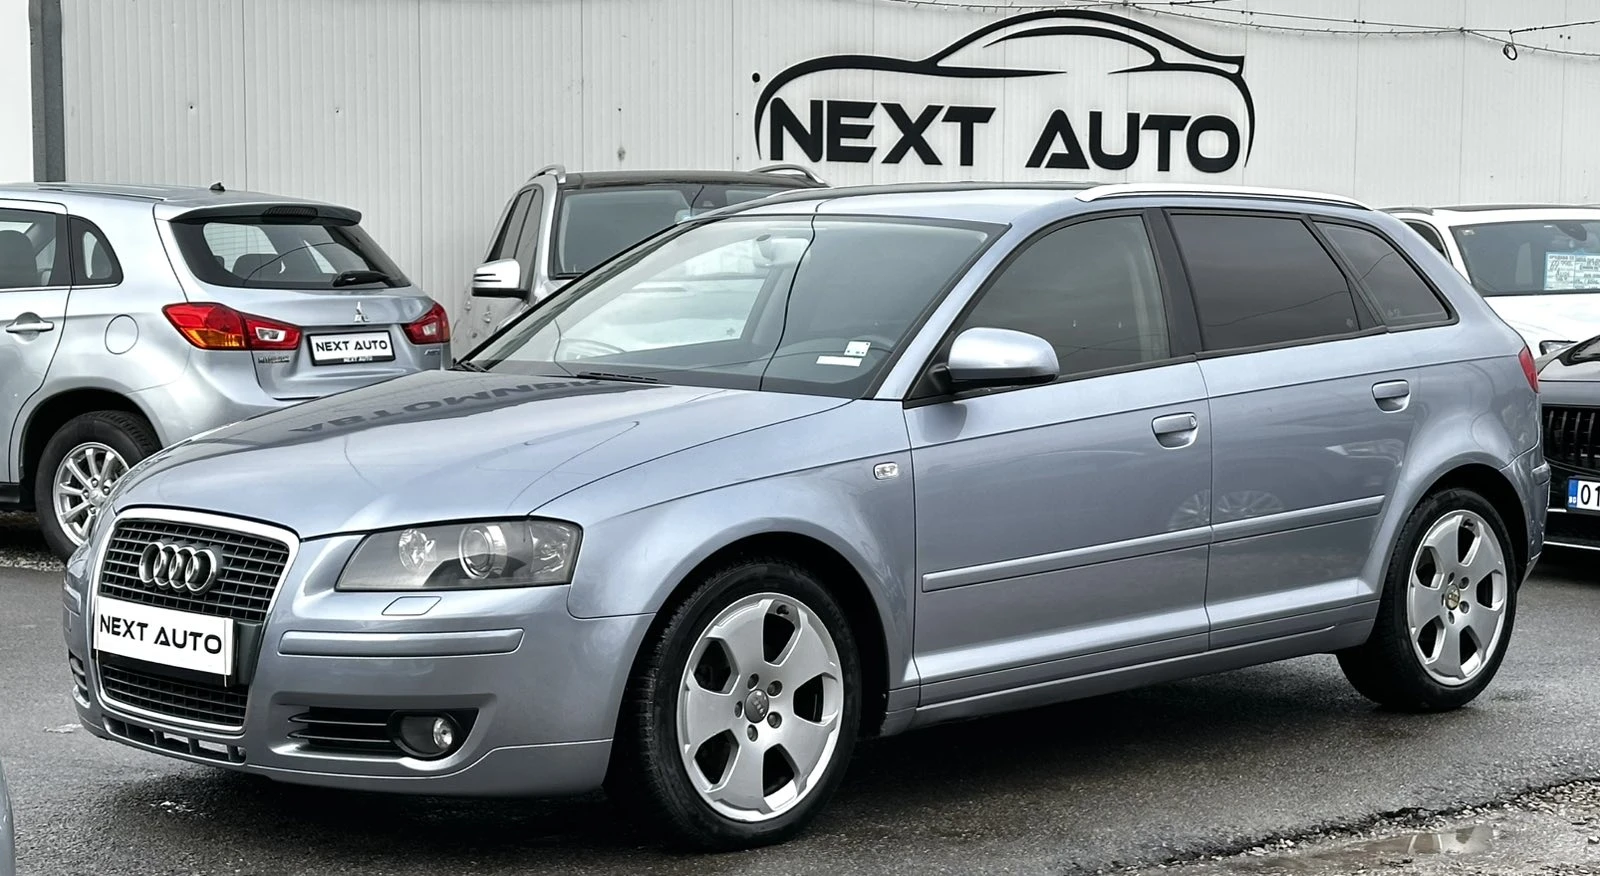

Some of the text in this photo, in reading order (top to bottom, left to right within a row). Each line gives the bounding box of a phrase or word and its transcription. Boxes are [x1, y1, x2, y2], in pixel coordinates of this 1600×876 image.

[770, 97, 1240, 174] NEXT AUTO
[315, 340, 387, 352] NEXT AUTO
[100, 614, 222, 655] NEXT AUTO
